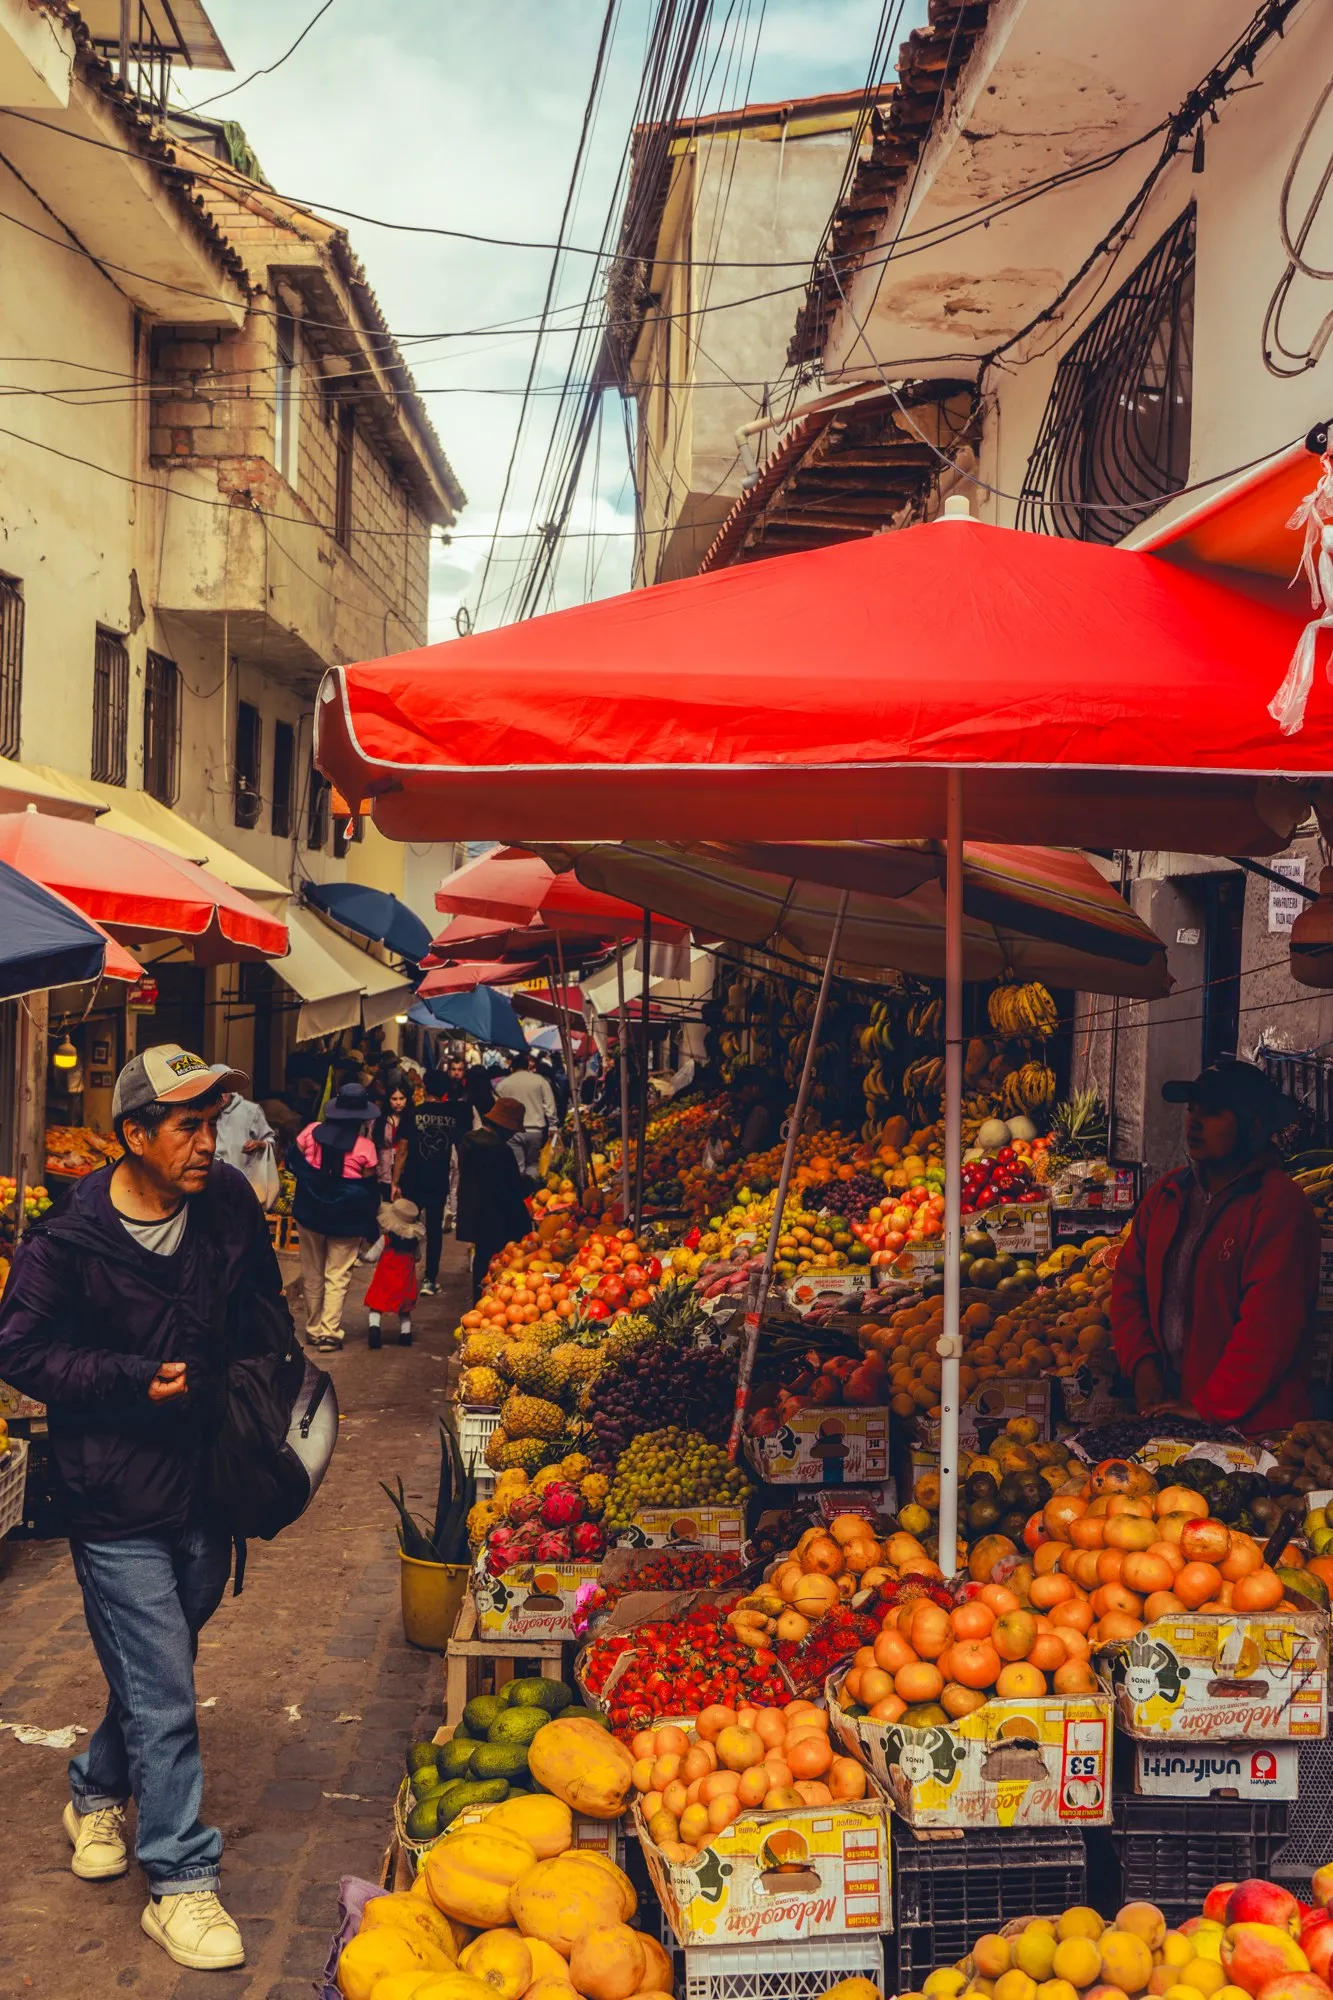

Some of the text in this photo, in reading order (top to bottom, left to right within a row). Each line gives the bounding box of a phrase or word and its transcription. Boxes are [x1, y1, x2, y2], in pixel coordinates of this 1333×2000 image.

[1131, 1676, 1151, 1685] HNOS
[1294, 1693, 1318, 1703] Marca
[1178, 1704, 1284, 1737] Melocotón
[904, 1757, 924, 1765] HNOS
[1071, 1757, 1096, 1775] 53
[1143, 1757, 1241, 1783] unifrutti
[1250, 1779, 1277, 1787] unifrutti
[738, 1818, 863, 1836] Huayco Crema
[846, 1849, 876, 1860] Puesto
[848, 1882, 876, 1893] Marca
[723, 1896, 837, 1937] Melocotón
[846, 1914, 878, 1927] Selección
